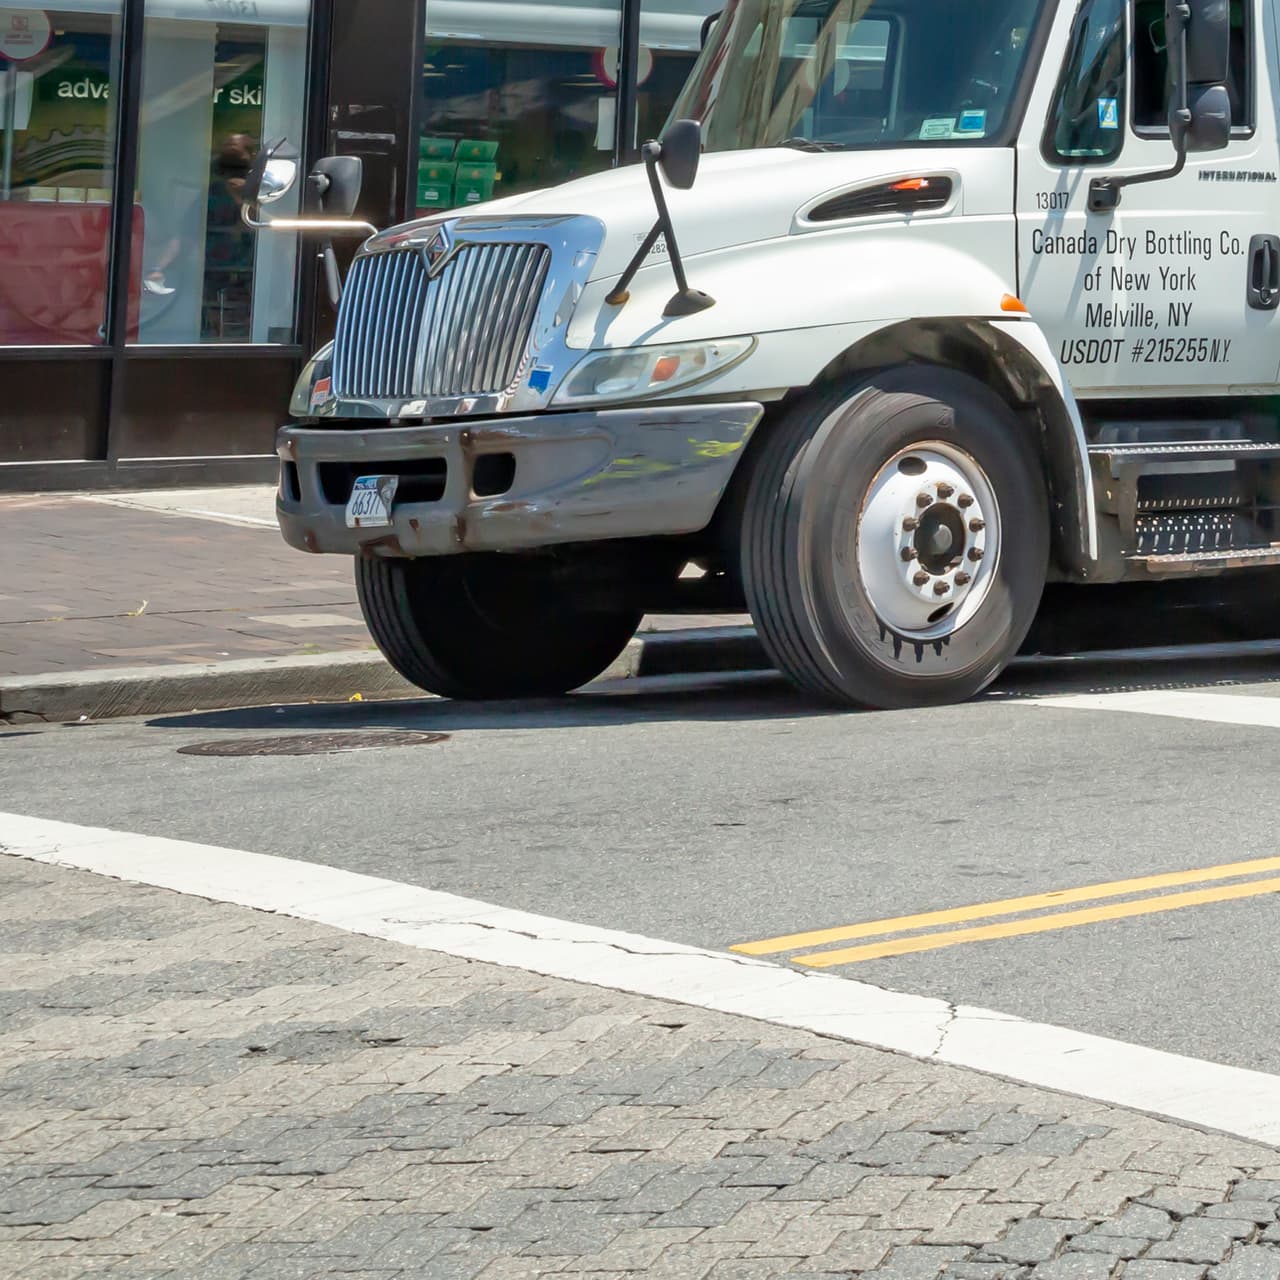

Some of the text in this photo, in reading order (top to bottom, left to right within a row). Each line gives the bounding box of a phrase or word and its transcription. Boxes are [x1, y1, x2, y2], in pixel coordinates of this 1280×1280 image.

[1198, 170, 1278, 182] INTERNATIONAL
[1036, 192, 1070, 210] 13017
[1032, 229, 1245, 260] Canada Dry Bottling Co.
[1083, 266, 1197, 291] of New York
[1085, 302, 1192, 330] Melville, NY
[1060, 337, 1232, 364] USDOT #215255 N.Y.
